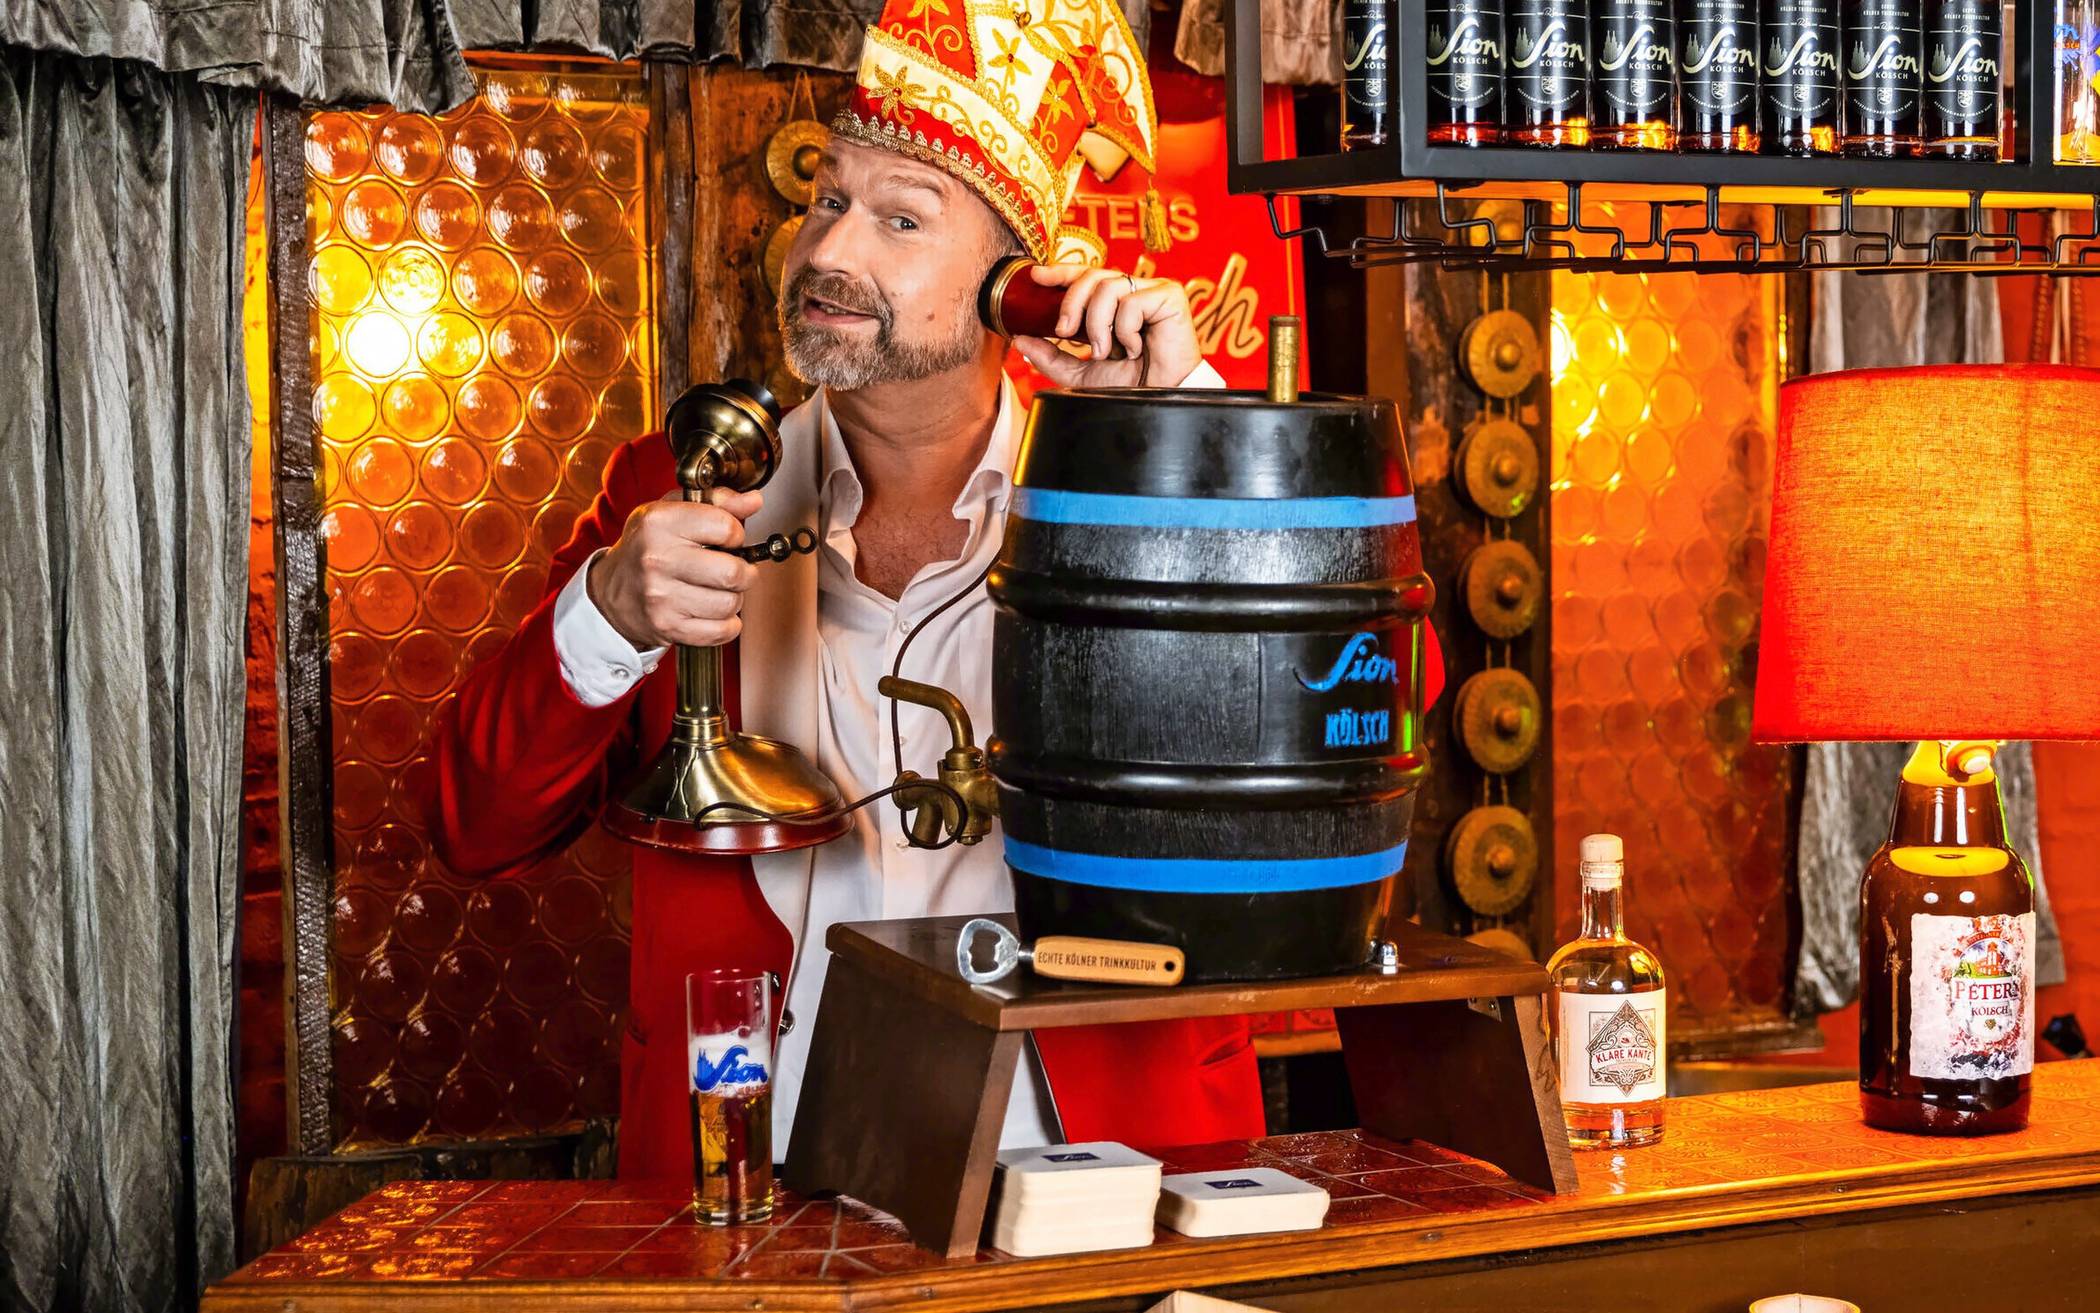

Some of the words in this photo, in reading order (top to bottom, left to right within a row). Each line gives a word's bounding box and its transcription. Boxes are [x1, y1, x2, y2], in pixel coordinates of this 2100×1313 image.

[1426, 17, 1500, 65] Sion
[1512, 21, 1585, 69] Sion
[1599, 24, 1673, 71] Sion
[1682, 27, 1755, 74] Sion
[1765, 30, 1837, 77] Sion
[1848, 34, 1919, 80] Sion
[1928, 37, 1999, 83] Sion
[1364, 61, 1386, 70] KÖLS
[1293, 632, 1399, 692] Sion
[1325, 707, 1390, 747] KÖLSCH
[1038, 951, 1063, 965] ECHTE
[1065, 952, 1098, 967] KÖLNER
[1099, 956, 1157, 971] TRINKKULTUR
[692, 1045, 768, 1092] Sion
[1596, 1049, 1625, 1064] KLARE
[1628, 1049, 1652, 1061] KANTE
